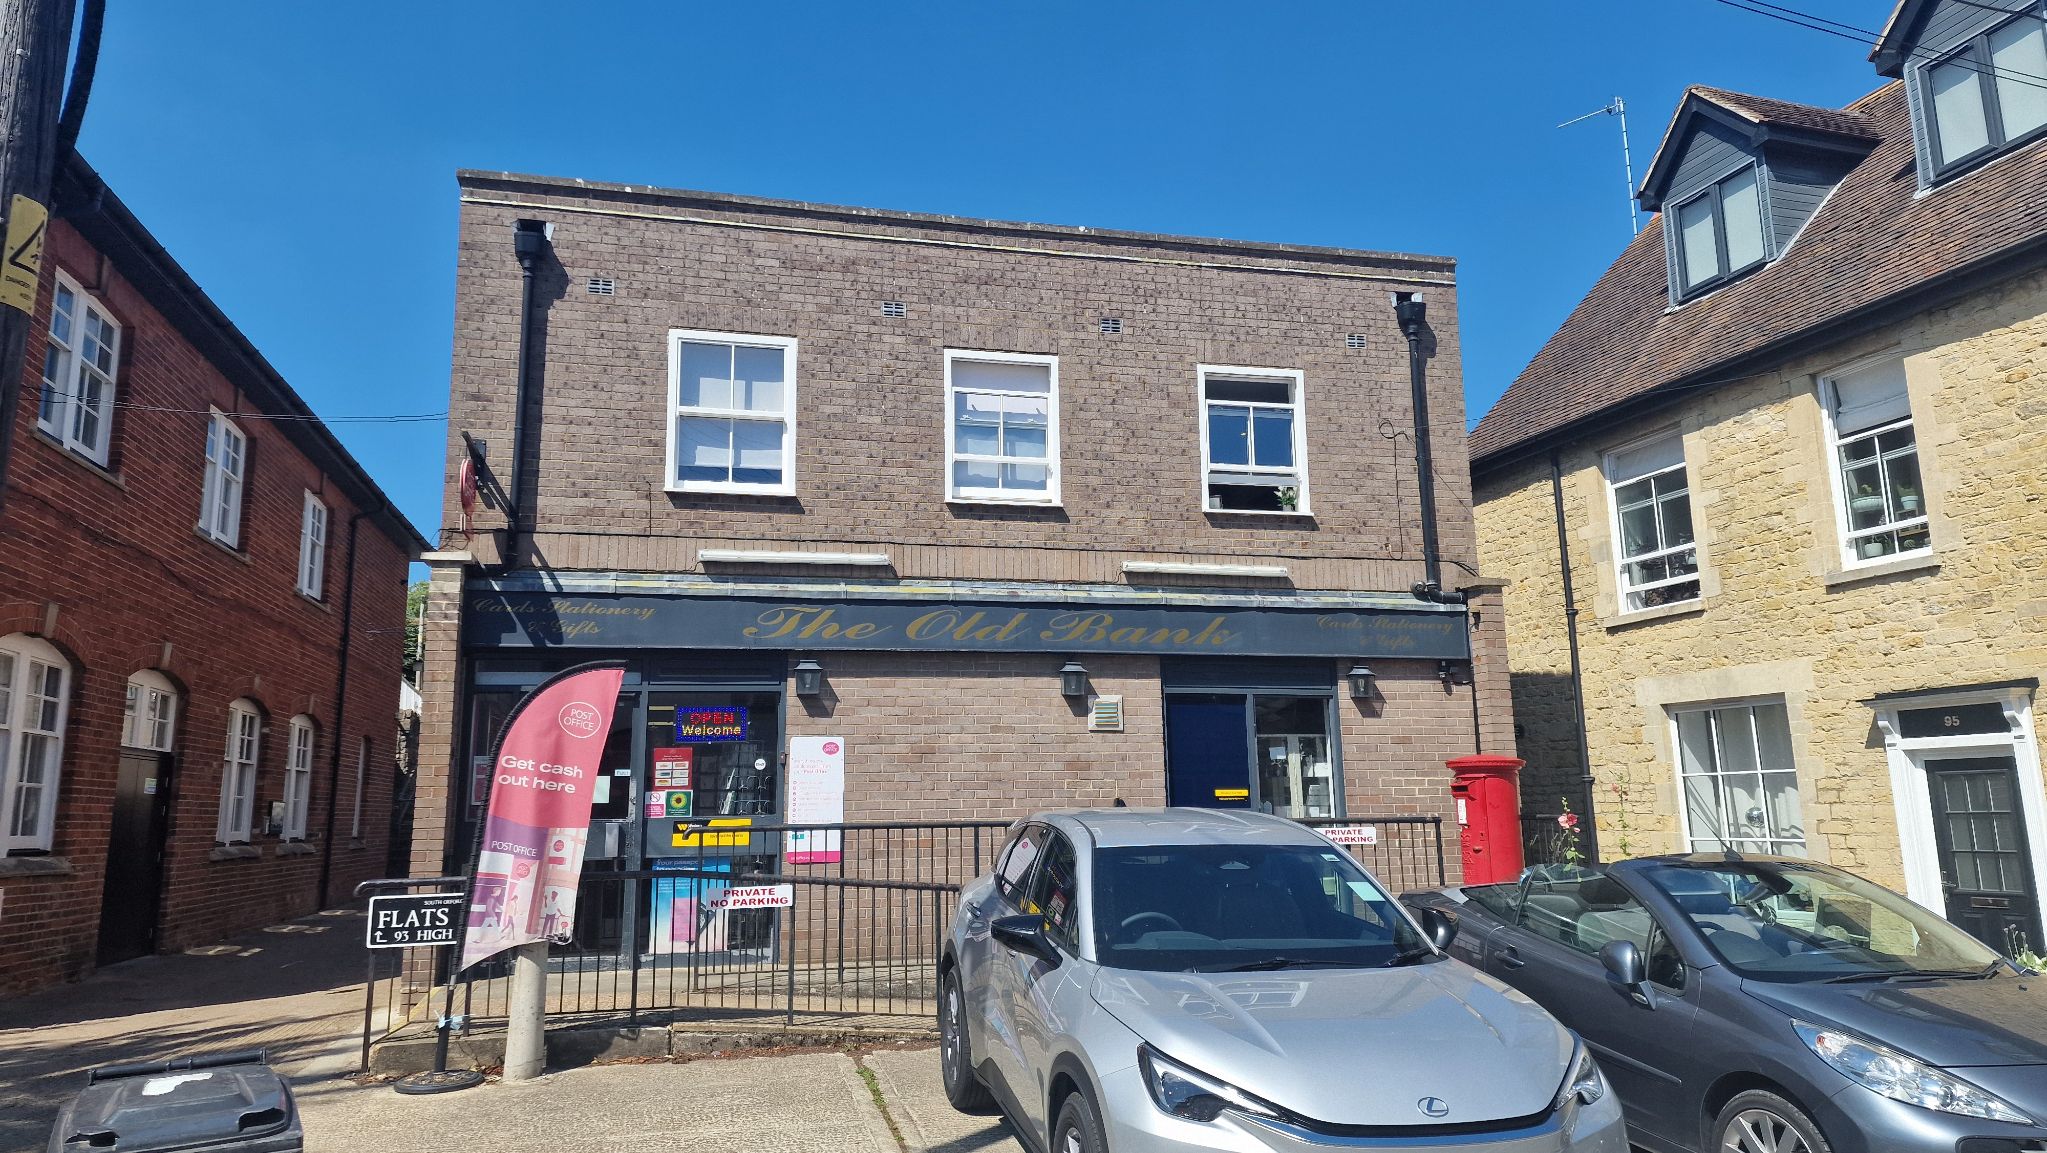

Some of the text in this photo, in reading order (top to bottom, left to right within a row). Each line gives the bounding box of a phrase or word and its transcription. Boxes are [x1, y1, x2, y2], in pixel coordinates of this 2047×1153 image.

[473, 599, 657, 619] Cards Stationery
[551, 620, 602, 639] Gifts
[743, 606, 1242, 646] The Old Bank
[570, 708, 594, 721] POST
[690, 712, 735, 724] OPEN
[1944, 715, 1960, 727] 95
[563, 716, 595, 731] OFFICE
[681, 724, 742, 736] Welcome
[501, 755, 583, 779] Get cash
[498, 774, 577, 794] out here
[1325, 828, 1363, 836] PRIVATE
[491, 840, 537, 857] POST OFFICE
[723, 887, 776, 898] PRIVATE
[710, 896, 788, 908] NO PARKING
[377, 907, 449, 929] FLATS
[394, 928, 453, 942] 93 HIGH
